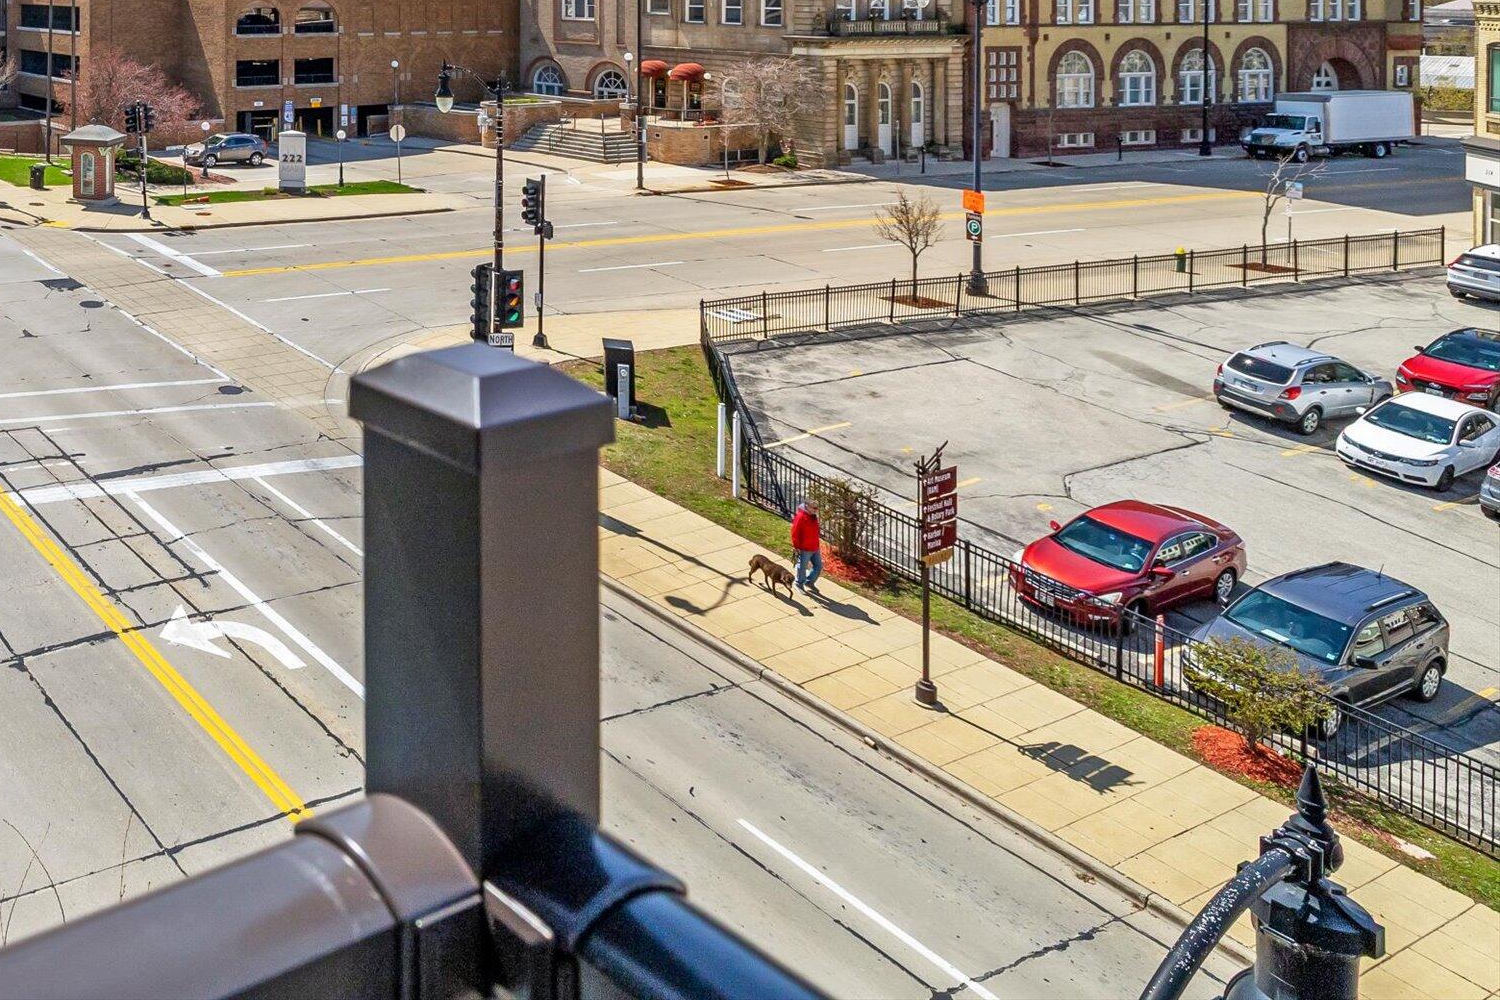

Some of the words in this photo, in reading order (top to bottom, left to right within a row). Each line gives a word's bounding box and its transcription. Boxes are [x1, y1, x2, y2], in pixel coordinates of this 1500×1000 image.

[282, 154, 302, 162] 222
[490, 334, 512, 344] NORTH
[935, 472, 950, 483] Museum
[927, 500, 943, 512] Festival
[944, 497, 952, 507] Hall
[945, 506, 955, 517] Park
